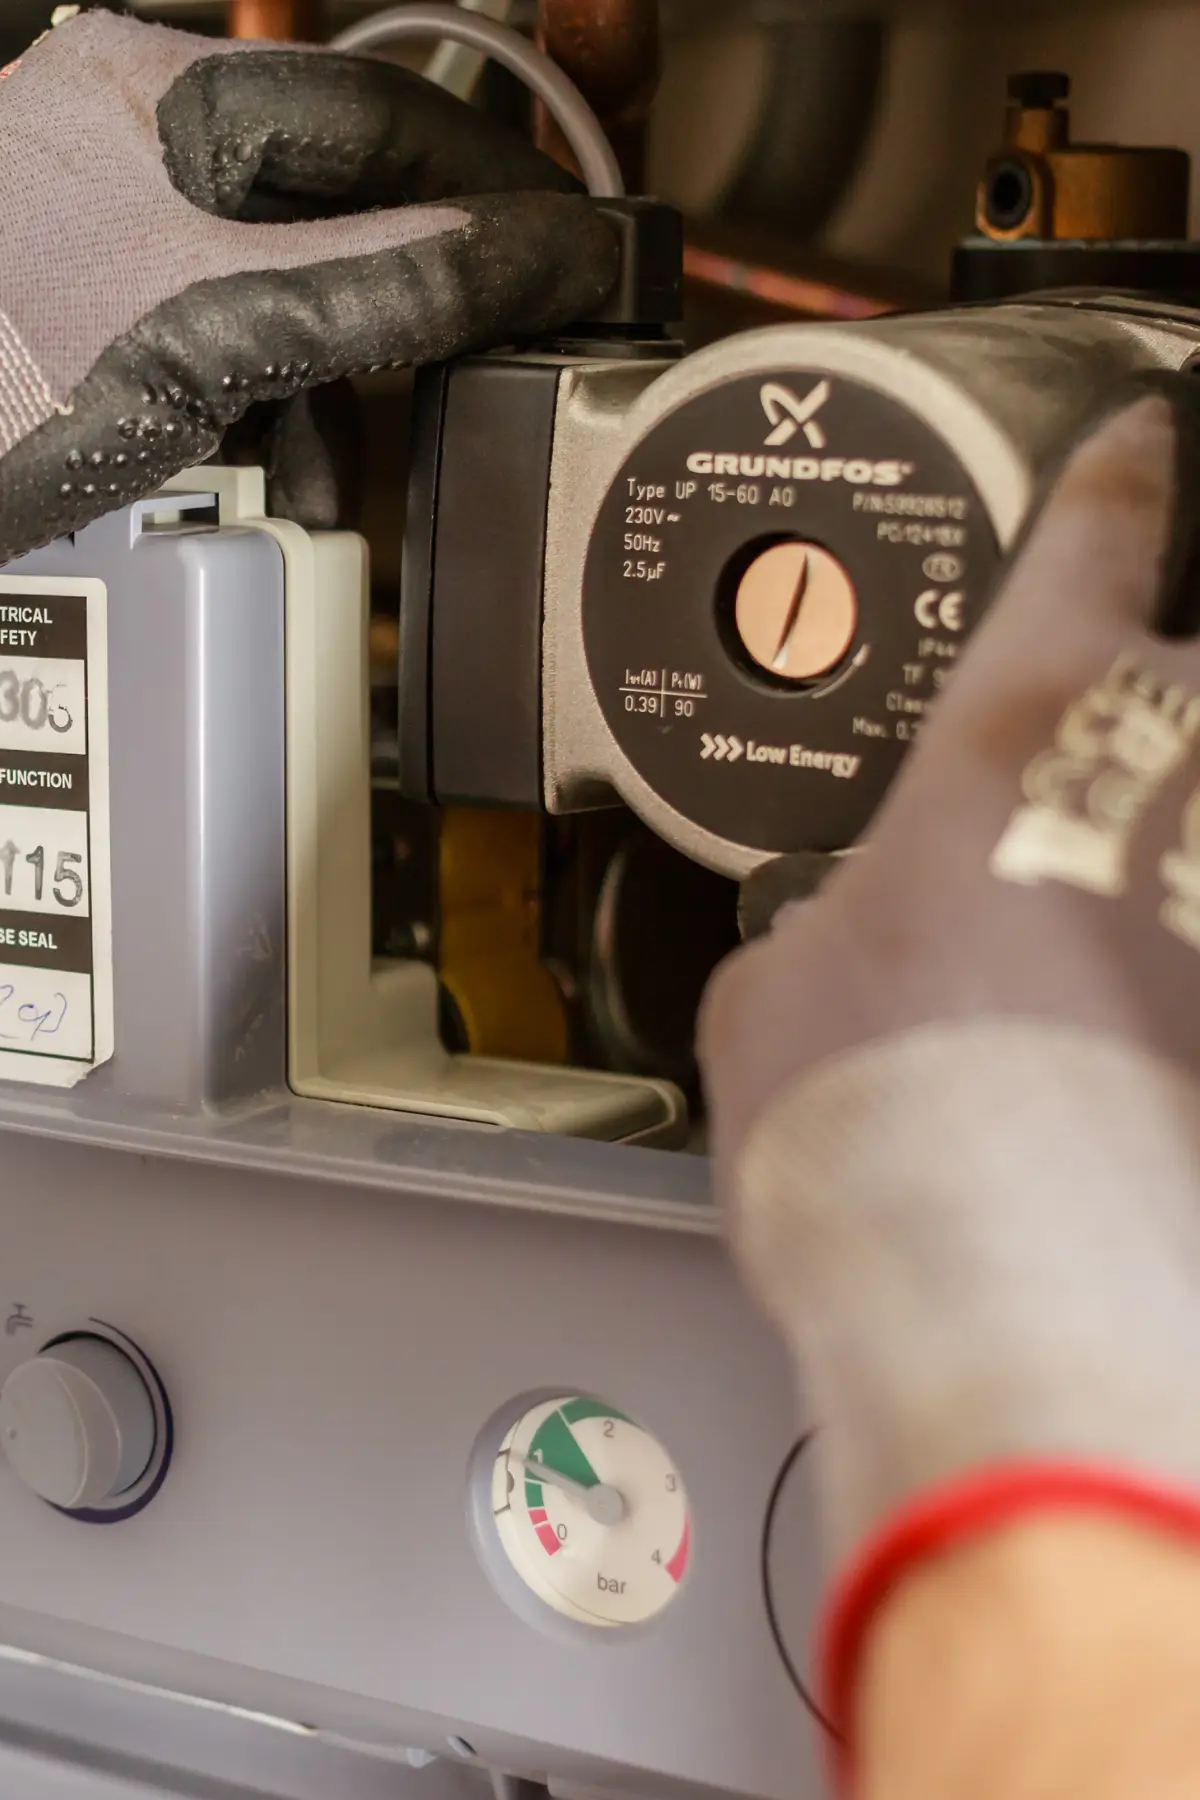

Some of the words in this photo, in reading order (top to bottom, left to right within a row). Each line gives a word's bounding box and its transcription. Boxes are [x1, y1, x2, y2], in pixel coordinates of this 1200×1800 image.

[687, 452, 902, 486] GRUNDFOS
[626, 477, 665, 501] Type
[675, 481, 697, 500] UP
[707, 484, 759, 505] 15-60
[624, 533, 661, 552] 50Hz
[625, 695, 657, 713] 0.39
[674, 700, 694, 717] 90
[746, 740, 788, 764] Low
[789, 744, 861, 779] Energy
[18, 931, 58, 949] SEAL
[603, 1419, 615, 1439] 2
[664, 1473, 677, 1493] 3
[556, 1523, 568, 1541] 0
[650, 1548, 662, 1565] 4
[597, 1572, 627, 1595] bar
